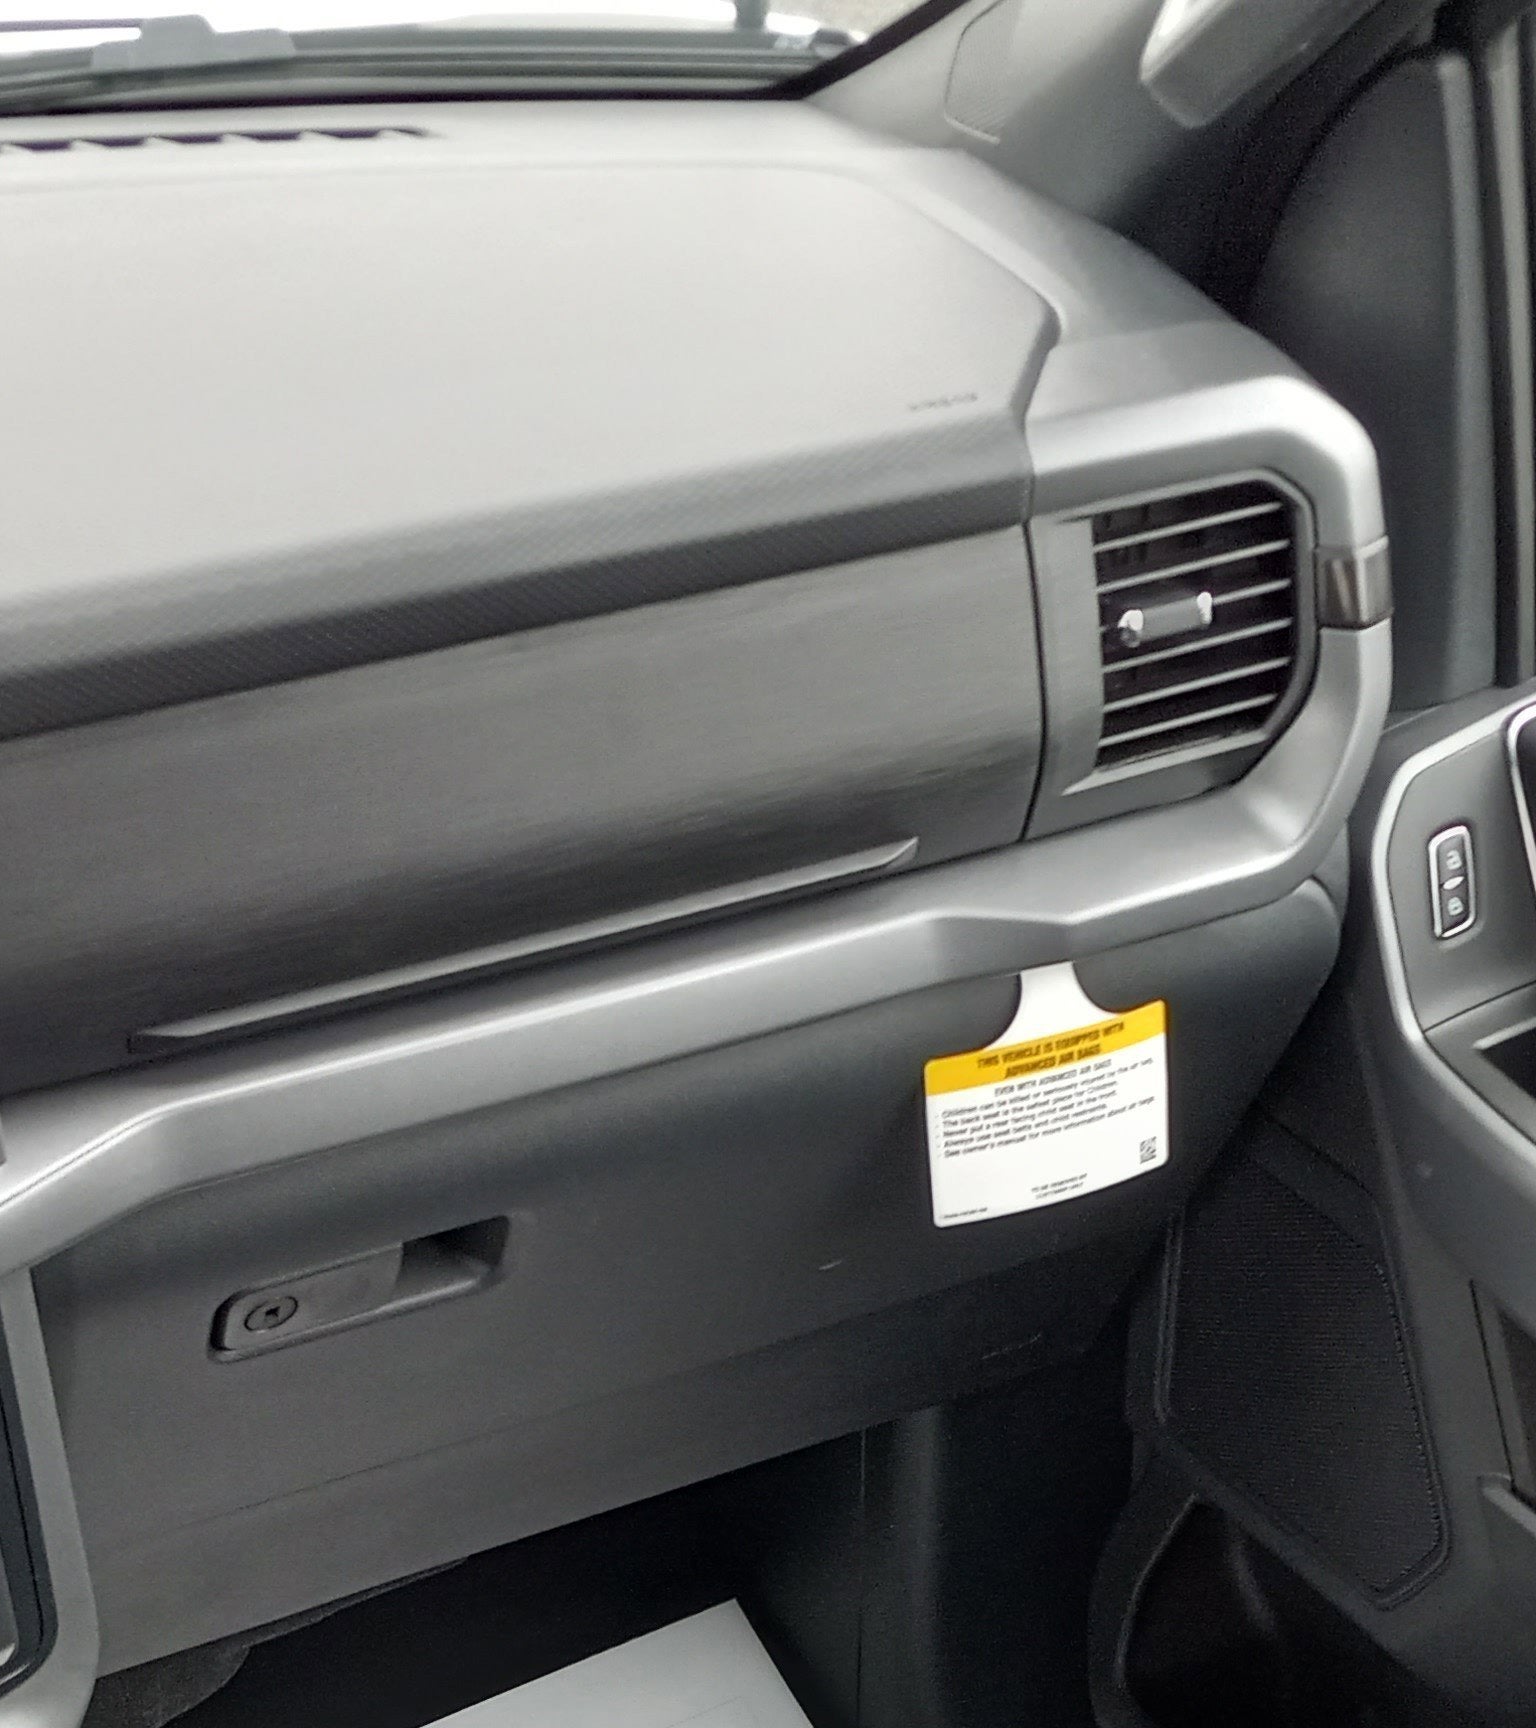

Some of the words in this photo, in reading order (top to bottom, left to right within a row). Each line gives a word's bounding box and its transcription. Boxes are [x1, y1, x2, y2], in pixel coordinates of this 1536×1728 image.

[976, 1054, 1000, 1069] THIS
[1001, 1044, 1042, 1063] VEHICLE
[1102, 1021, 1124, 1038] WITH
[1004, 1056, 1057, 1079] ADVANCED
[1058, 1050, 1075, 1066] AIR
[1076, 1043, 1101, 1060] BAGS
